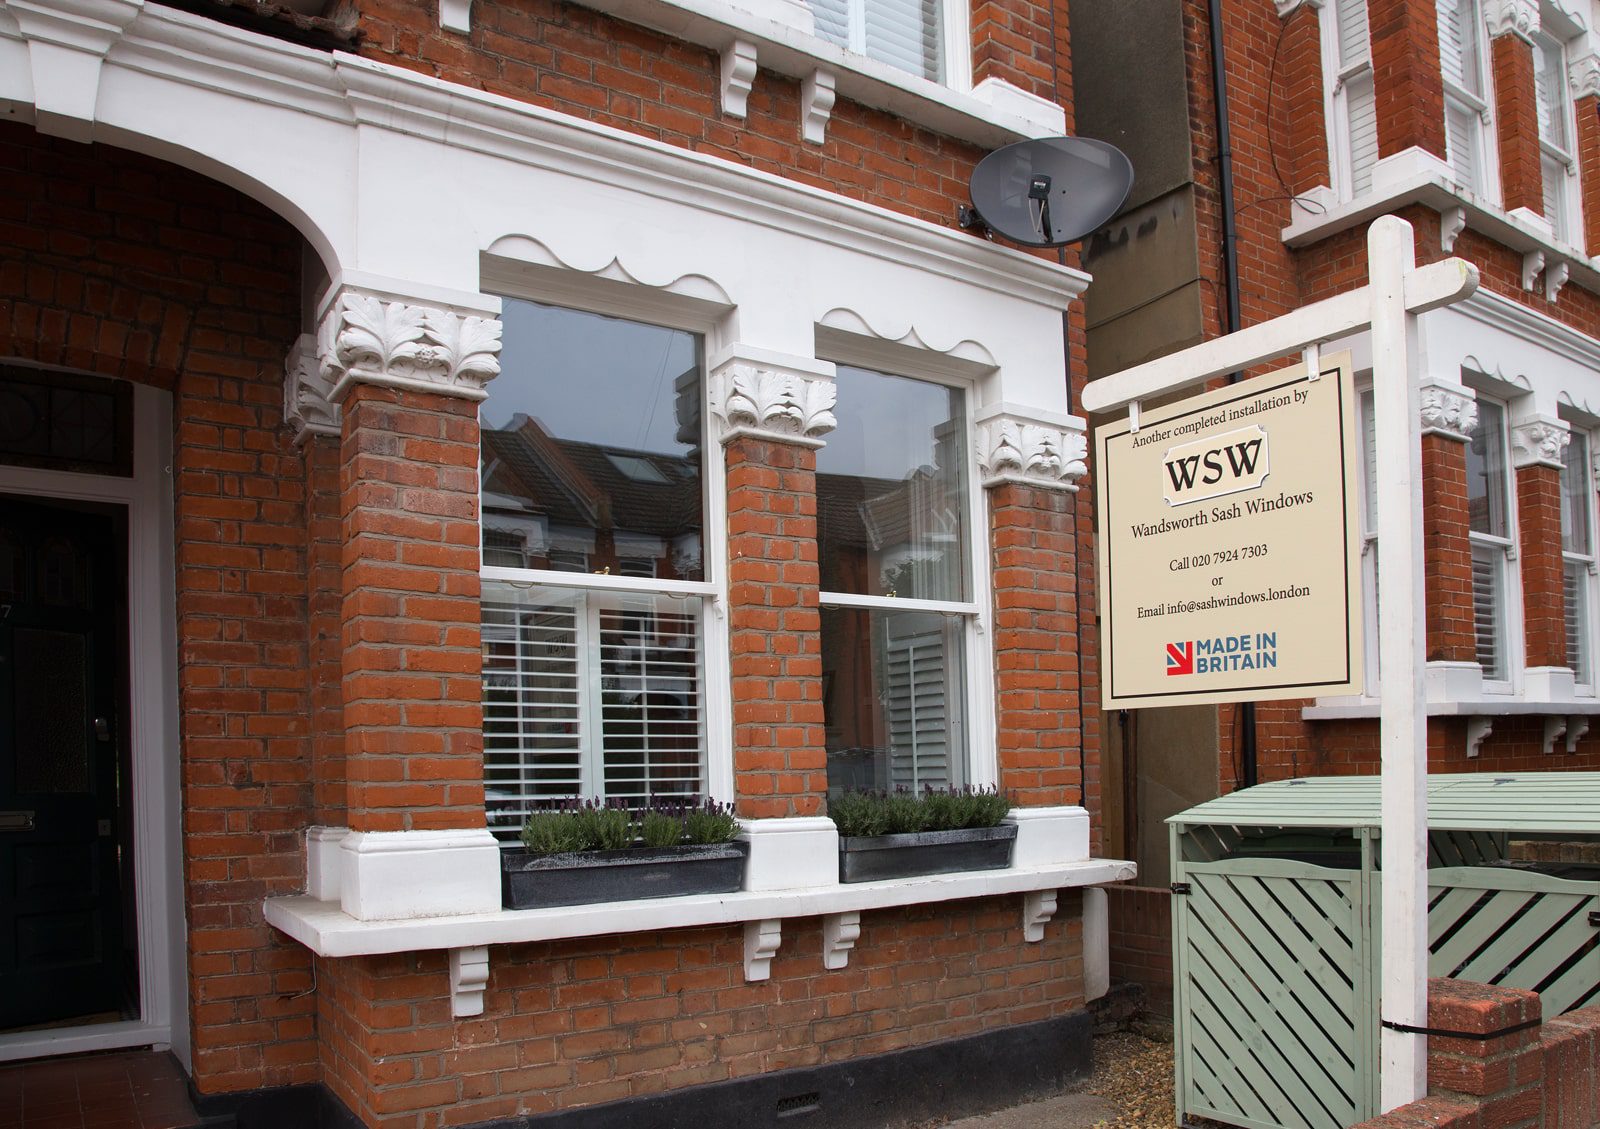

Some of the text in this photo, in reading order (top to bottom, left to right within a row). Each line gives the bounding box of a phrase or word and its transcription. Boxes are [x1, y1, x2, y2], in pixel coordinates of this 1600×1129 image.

[1132, 389, 1309, 449] Another completed installation by
[1165, 438, 1263, 492] WSW
[1131, 490, 1314, 539] Wandsworth Sash Windows
[1169, 543, 1268, 572] Call 020 7924 7303
[1210, 576, 1224, 587] or
[1137, 584, 1311, 619] Email info@sashwindows.london
[1196, 631, 1277, 656] MADE IN
[1196, 650, 1277, 674] BRITAIN
